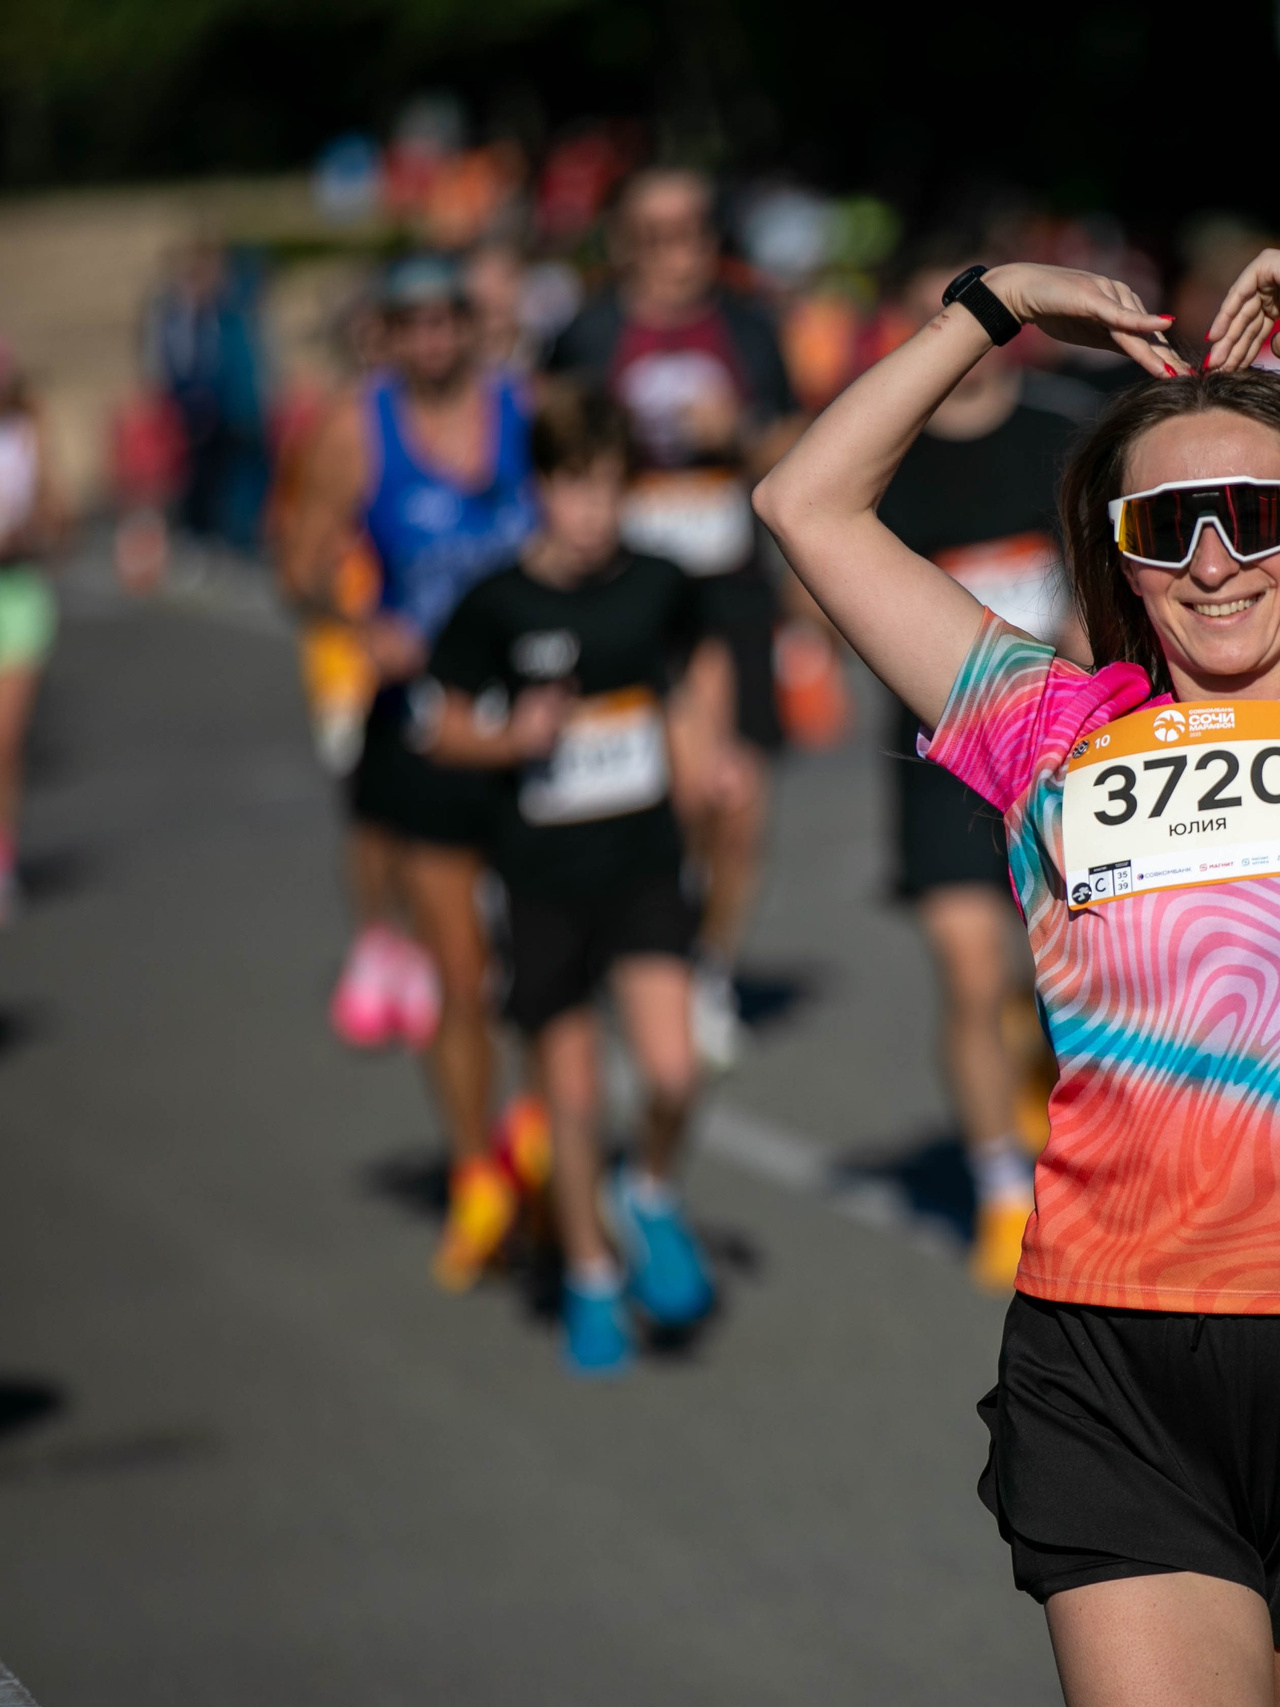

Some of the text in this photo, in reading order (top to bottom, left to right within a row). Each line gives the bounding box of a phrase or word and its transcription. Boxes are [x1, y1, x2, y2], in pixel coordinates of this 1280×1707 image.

[1189, 712, 1235, 725] СОЧИ
[1189, 722, 1236, 731] МАРАФОН
[1094, 734, 1111, 749] 10
[1168, 817, 1228, 837] ЮЛИЯ
[1117, 871, 1128, 879] 35
[1117, 882, 1129, 890] 39
